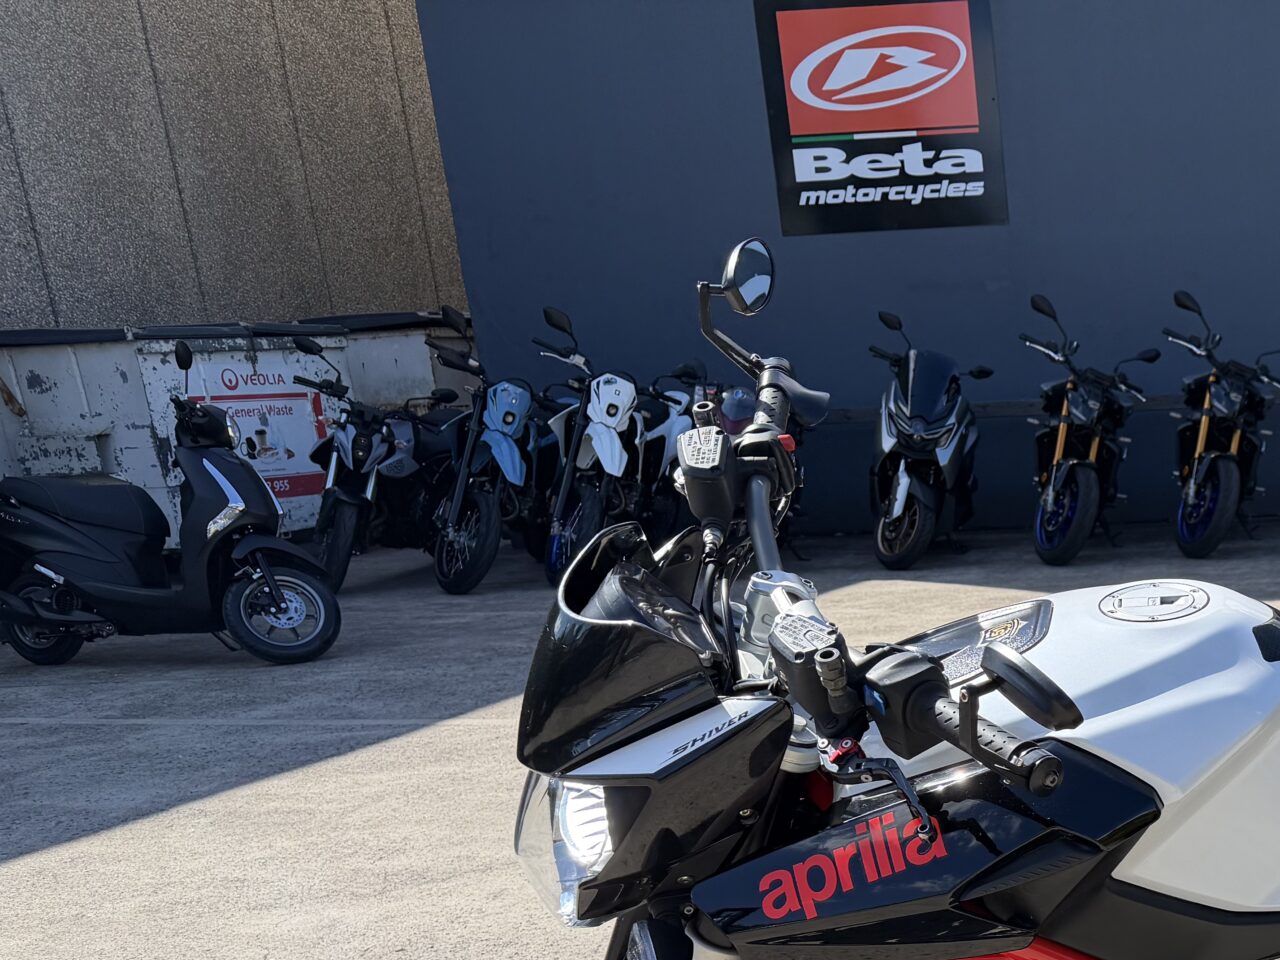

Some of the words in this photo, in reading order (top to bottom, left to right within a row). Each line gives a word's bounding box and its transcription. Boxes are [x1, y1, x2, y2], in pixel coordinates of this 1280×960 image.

[792, 141, 984, 183] Beta
[799, 180, 984, 206] motorcycles
[240, 373, 285, 385] VEOLIA
[227, 404, 265, 418] General
[265, 404, 294, 417] Waste
[668, 709, 750, 758] SHIVER
[758, 811, 949, 921] aprilia
